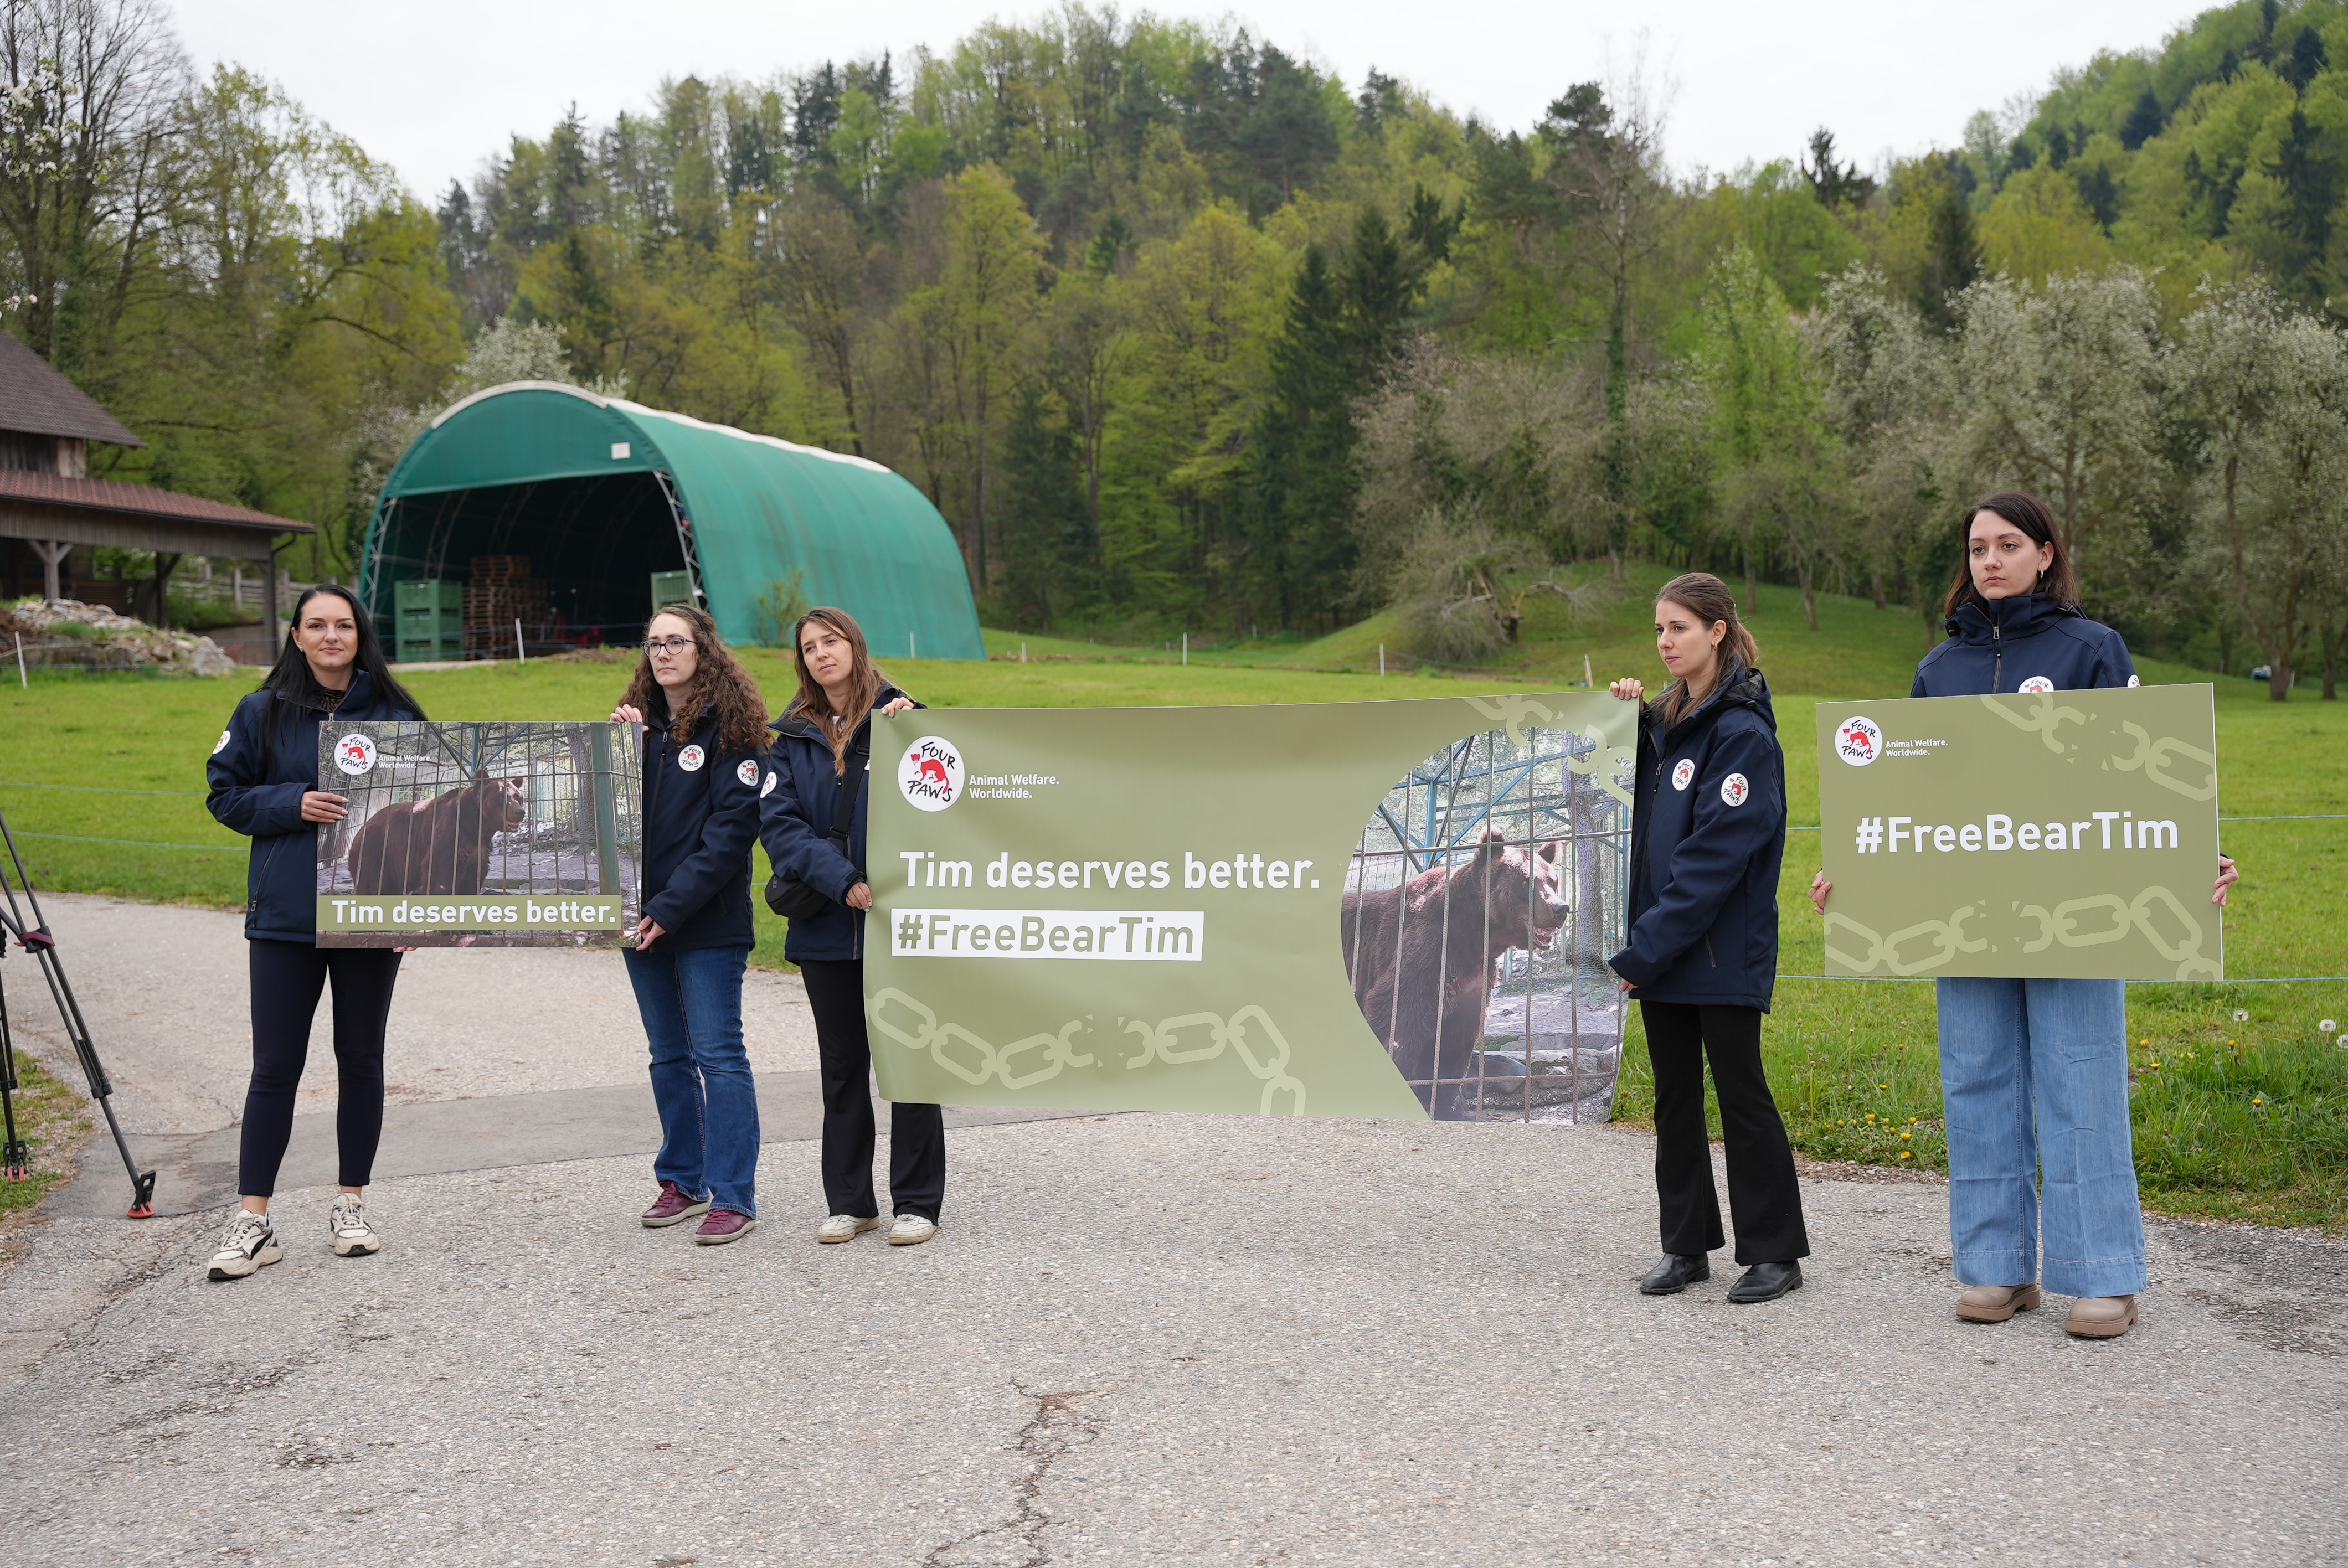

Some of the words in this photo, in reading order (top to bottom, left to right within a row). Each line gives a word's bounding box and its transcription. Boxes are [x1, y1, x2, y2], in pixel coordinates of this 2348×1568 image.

[2030, 678, 2049, 689] FOUR
[1851, 720, 1876, 738] FOUR
[349, 736, 371, 752] FOUR
[688, 746, 702, 756] FOUR
[1885, 740, 1913, 748] Animal
[1914, 739, 1948, 747] Welfare.
[921, 741, 956, 770] FOUR
[1841, 745, 1875, 760] PAWS
[1886, 749, 1930, 757] Worldwide.
[339, 757, 368, 770] PAWS
[682, 760, 699, 768] PAWS
[1682, 761, 1693, 773] FOUR
[969, 774, 1008, 786] Animal
[1011, 773, 1059, 785] Welfare.
[1675, 777, 1689, 786] PAWS
[1734, 777, 1748, 793] FOUR
[907, 780, 953, 802] PAWS
[969, 787, 1033, 799] Worldwide.
[1723, 788, 1741, 804] PAWS
[1855, 811, 2179, 853] #FreeBearTim
[899, 851, 973, 888] Tim
[985, 851, 1171, 888] deserves
[1183, 851, 1320, 889] better.
[331, 900, 383, 924] Tim
[392, 900, 519, 924] deserves
[526, 900, 616, 924] better.
[898, 914, 1193, 953] #FreeBearTim
